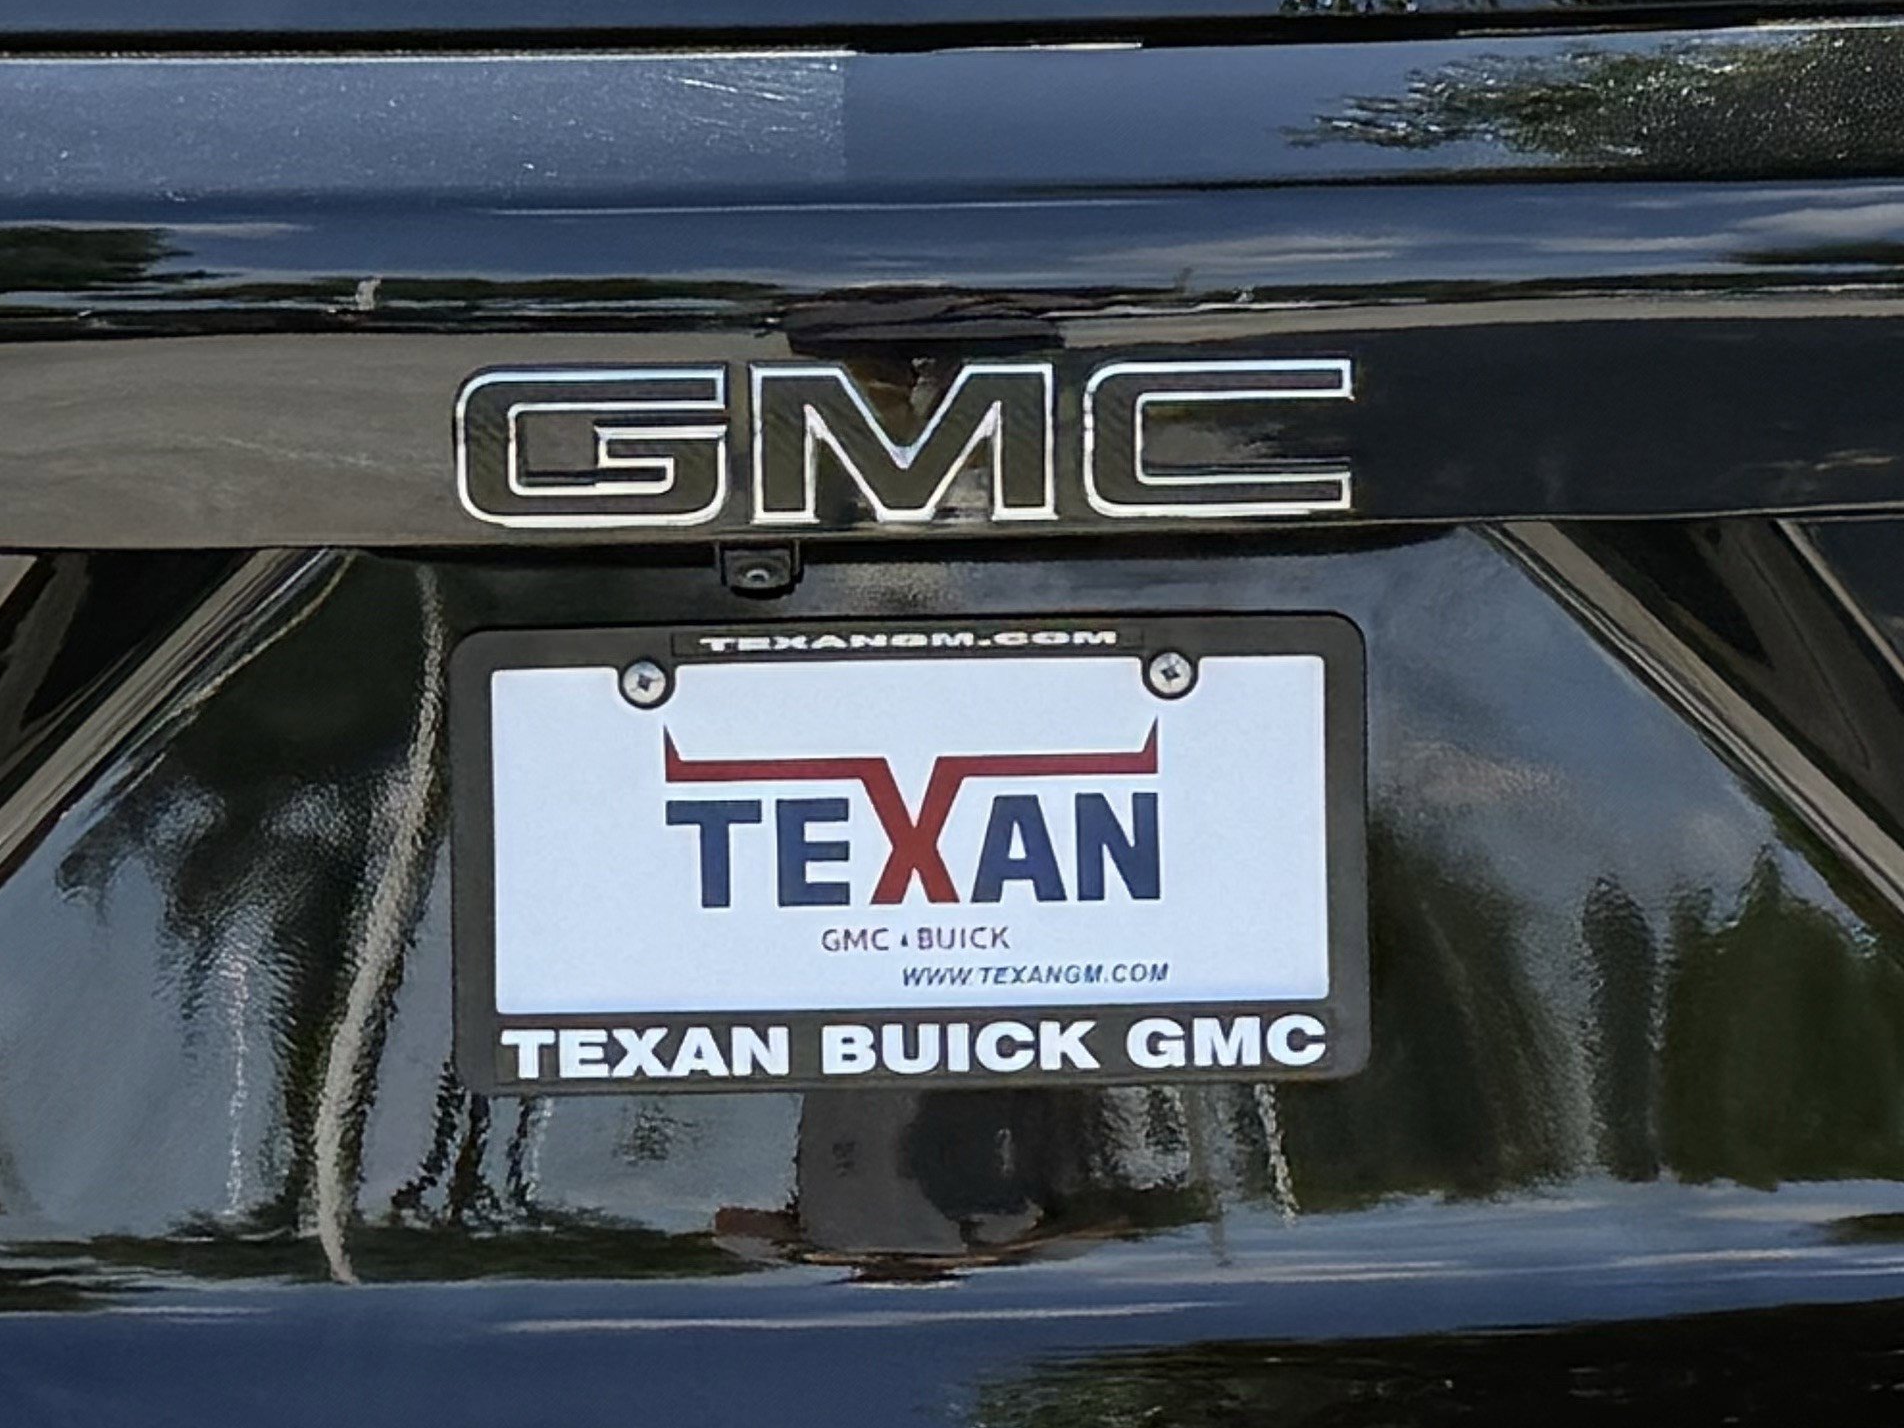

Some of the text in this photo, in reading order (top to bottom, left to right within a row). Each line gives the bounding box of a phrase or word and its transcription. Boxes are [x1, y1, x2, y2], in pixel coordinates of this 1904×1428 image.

[453, 359, 1354, 529] GMC
[699, 629, 1117, 653] TEXANGM.COM
[664, 754, 1161, 908] TEXAN
[821, 925, 1011, 952] GMC BUICK
[901, 961, 1170, 987] WWW.TEXANGM.COM
[500, 1013, 1328, 1080] TEXAN BUICK GMC
